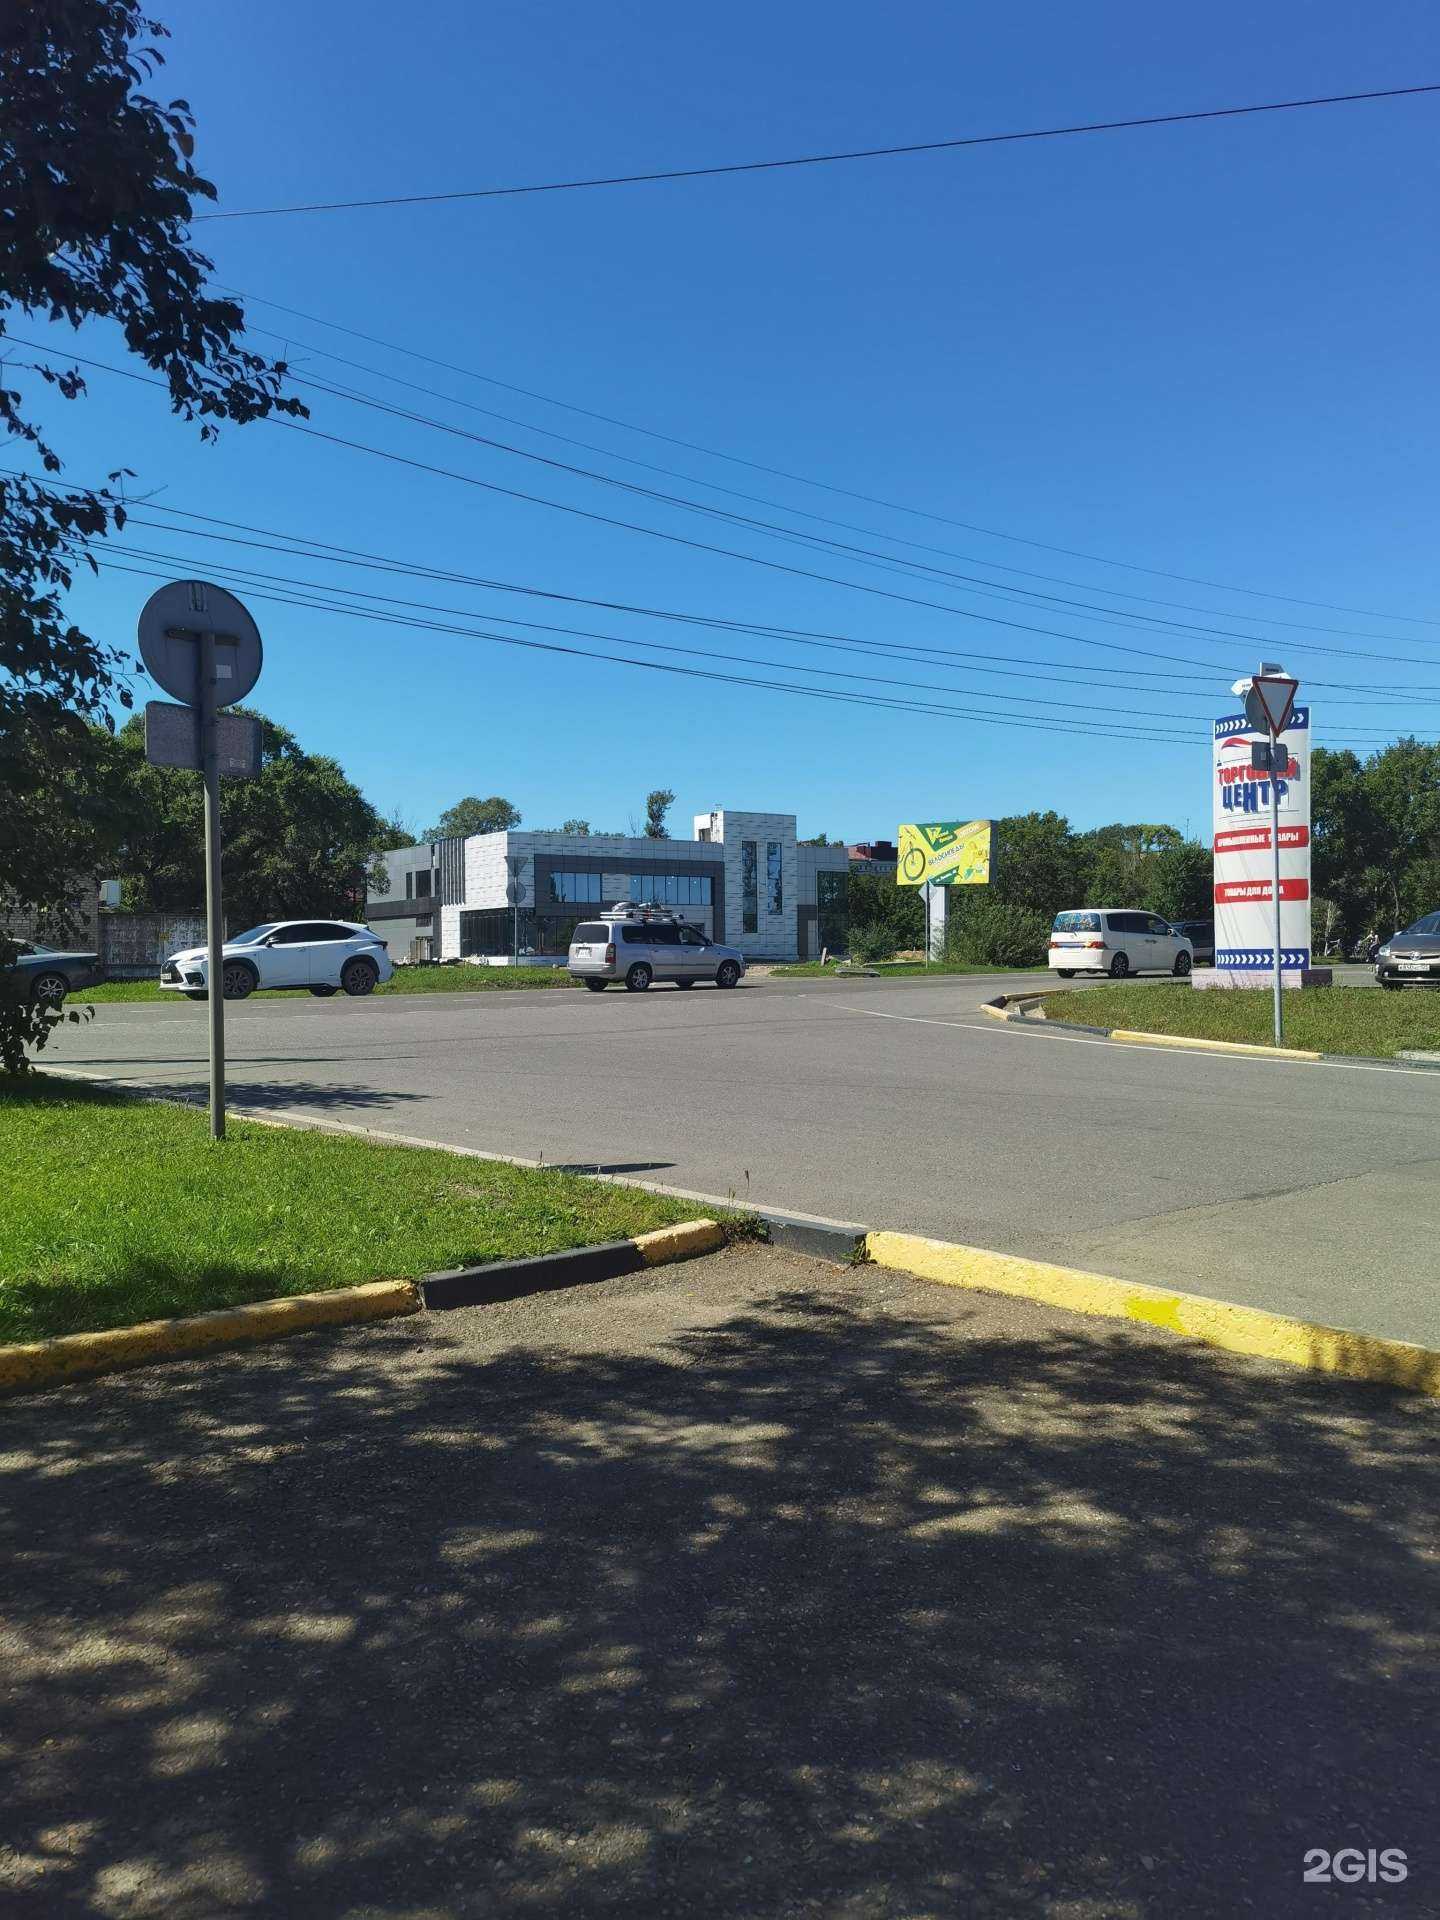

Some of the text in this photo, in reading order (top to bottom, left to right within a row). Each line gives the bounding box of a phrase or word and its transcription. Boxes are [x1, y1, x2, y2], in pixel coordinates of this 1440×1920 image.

[1222, 779, 1289, 813] ЦЕНТР
[1268, 832, 1299, 842] ТВАРЫ
[1262, 885, 1284, 896] ДОА
